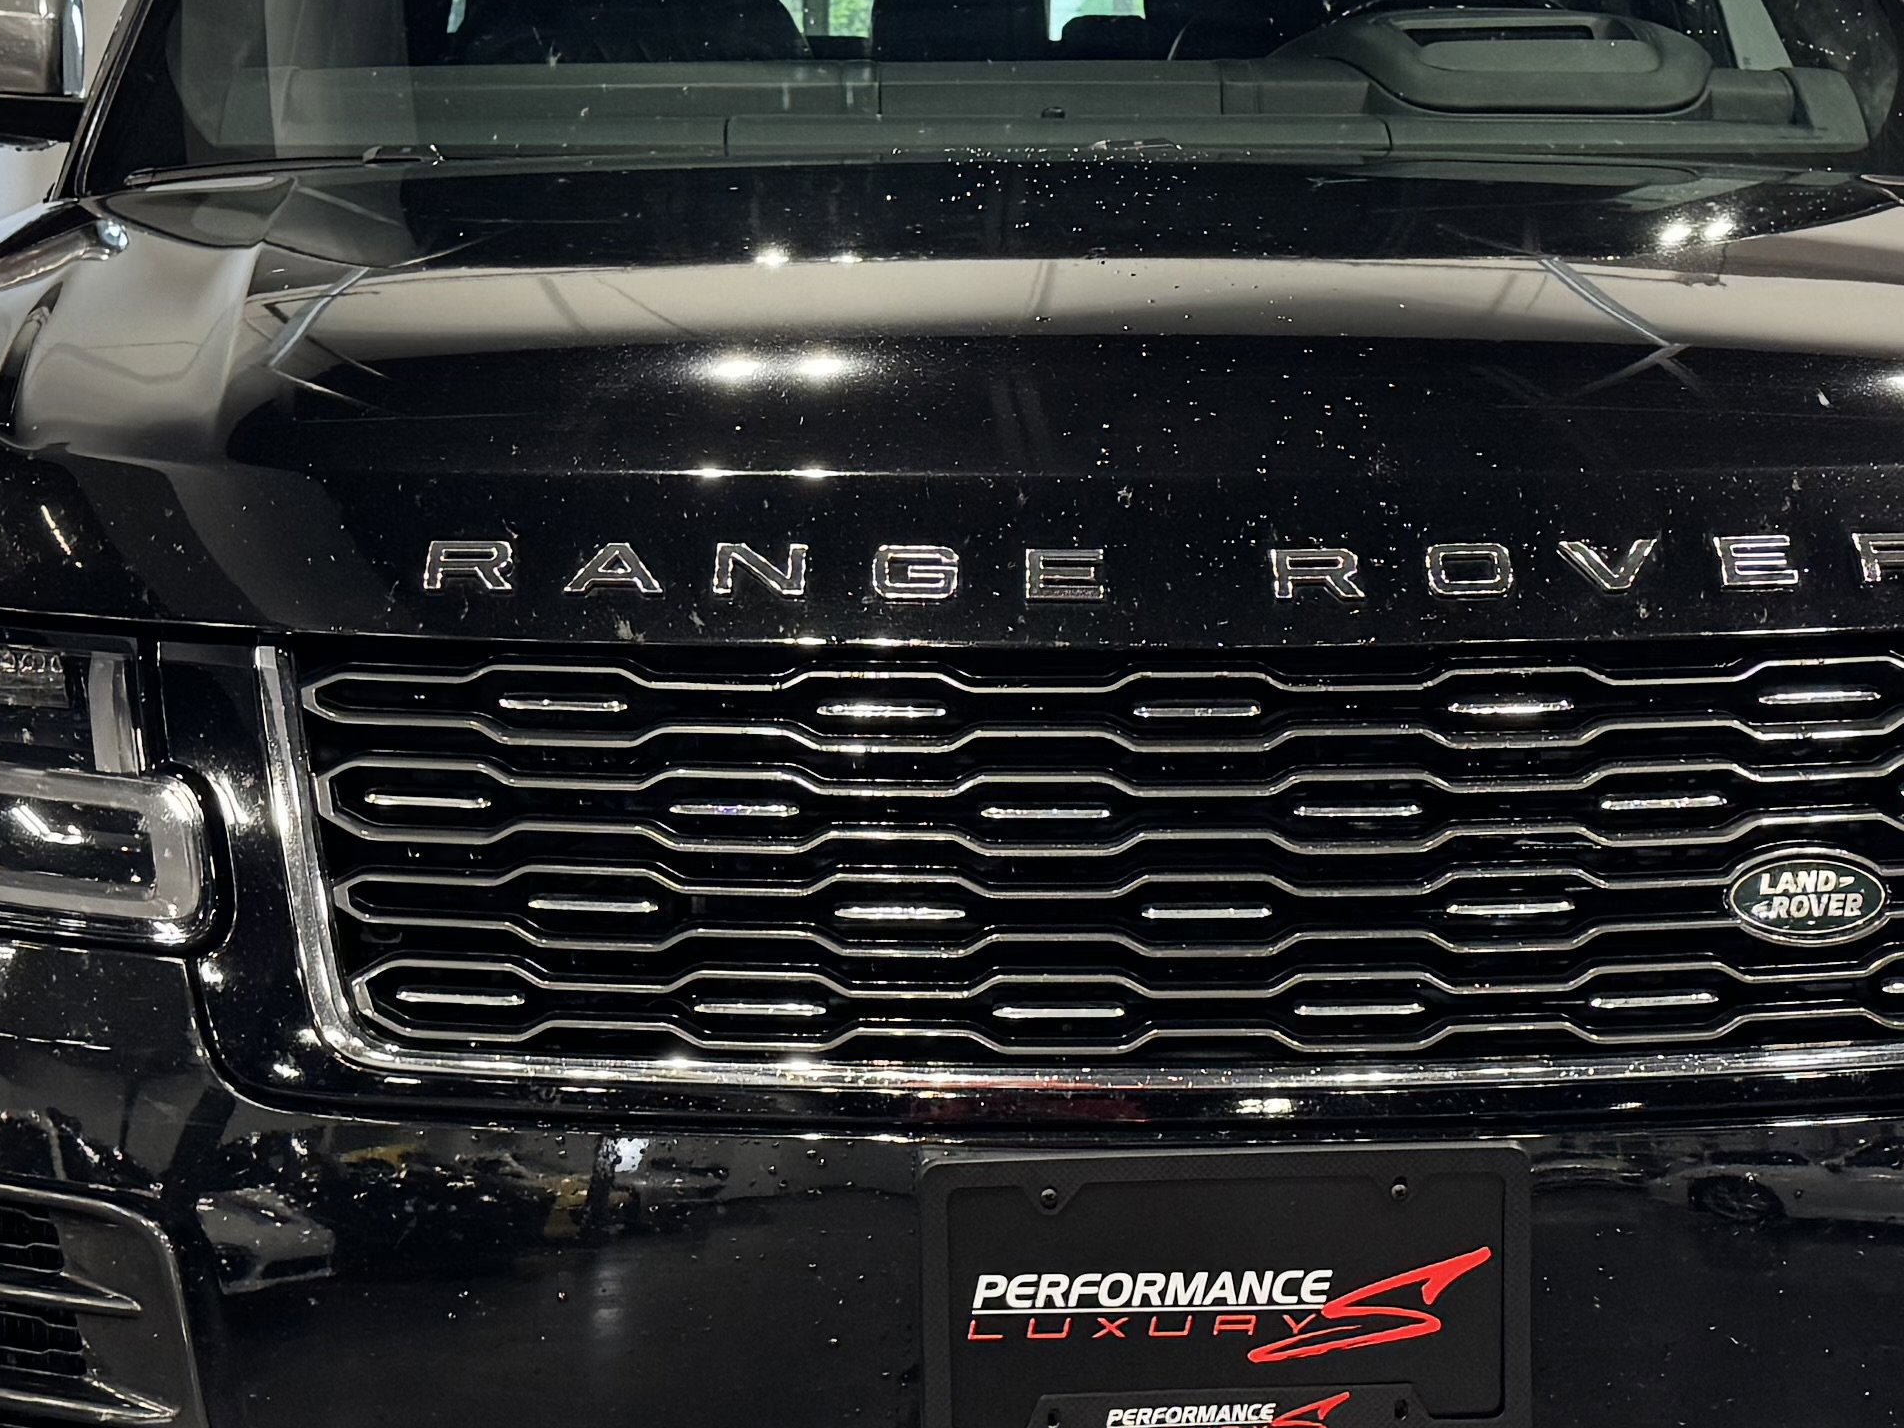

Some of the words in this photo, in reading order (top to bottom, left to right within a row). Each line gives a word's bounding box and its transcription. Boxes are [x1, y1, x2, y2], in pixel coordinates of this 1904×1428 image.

[422, 539, 1106, 600] RANGE
[1759, 870, 1839, 896] LAND
[1771, 892, 1865, 919] ROVER
[971, 1269, 1334, 1309] PERFORMANCE
[1106, 1402, 1277, 1427] PERFORMANCE
